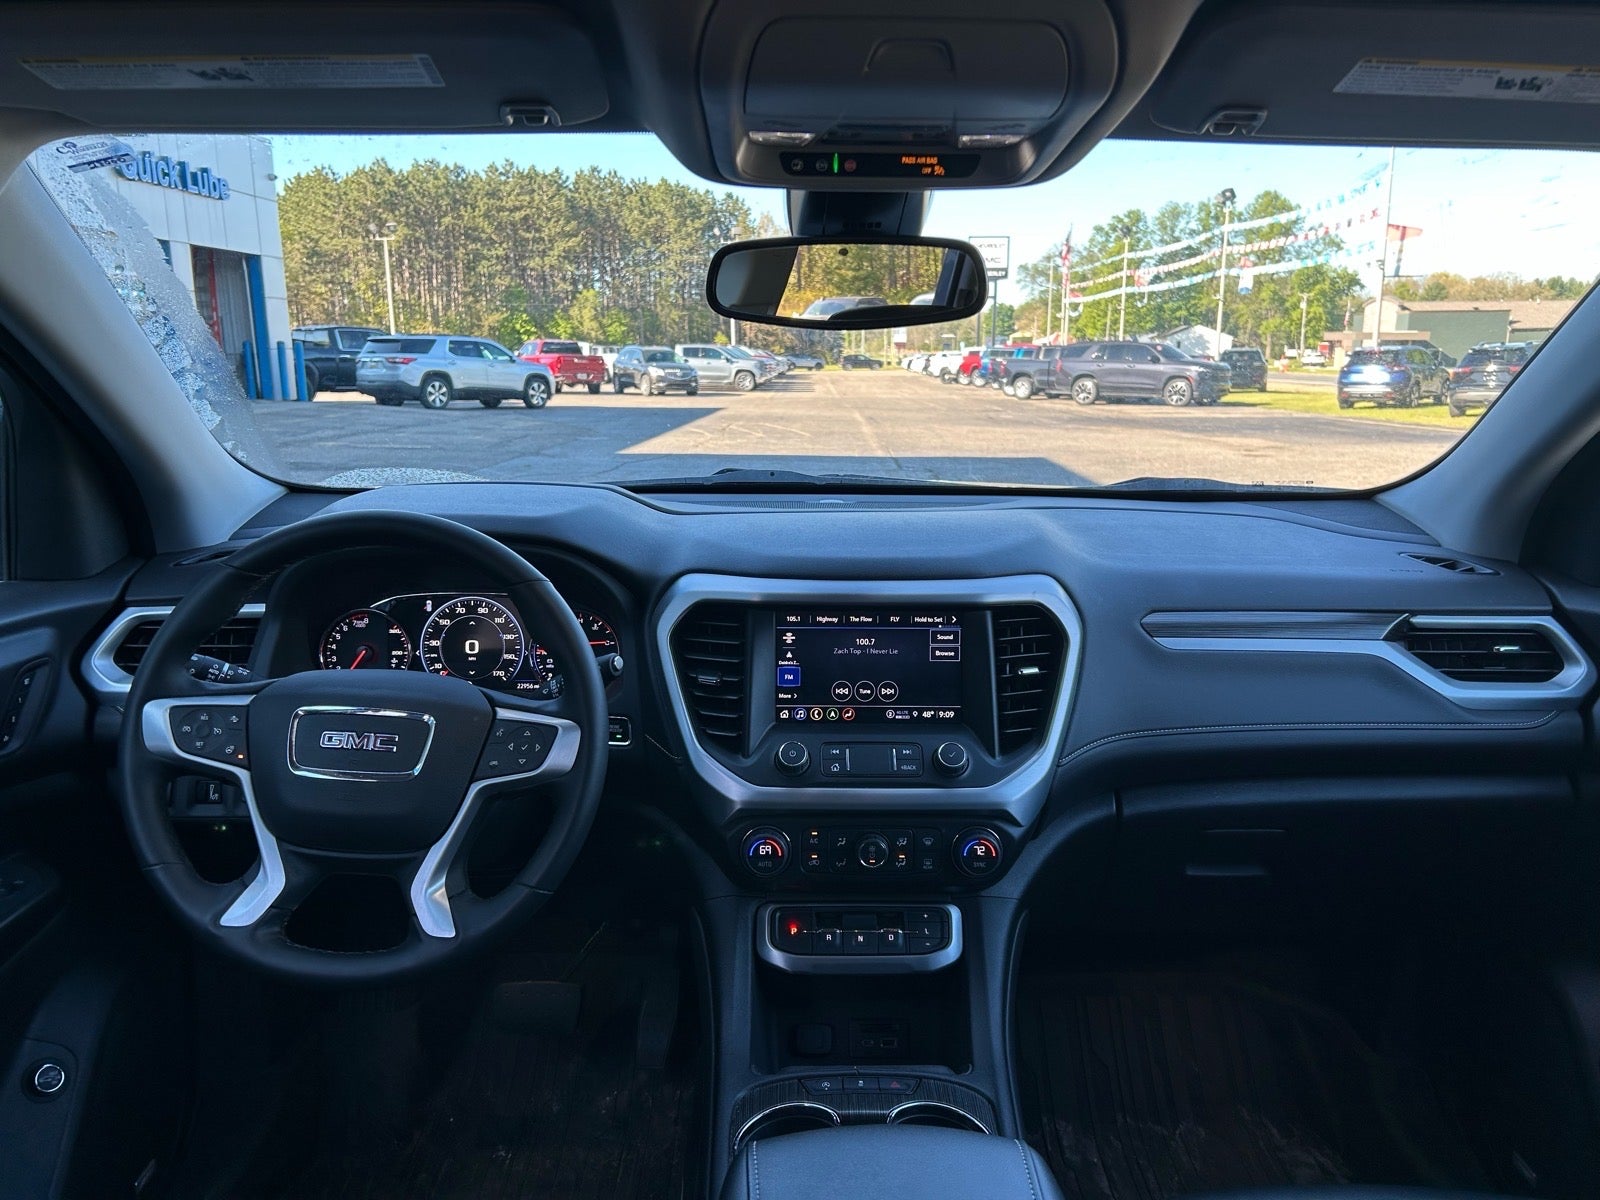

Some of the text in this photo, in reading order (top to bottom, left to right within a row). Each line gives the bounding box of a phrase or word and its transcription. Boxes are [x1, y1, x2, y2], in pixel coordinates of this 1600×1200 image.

[901, 156, 938, 164] PASS AIR BAG
[119, 151, 231, 201] Quick Lube
[464, 639, 480, 654] 0
[848, 648, 861, 656] Top
[922, 710, 934, 718] 48°
[319, 730, 399, 753] GMC
[759, 845, 772, 855] 69
[974, 846, 986, 856] 72
